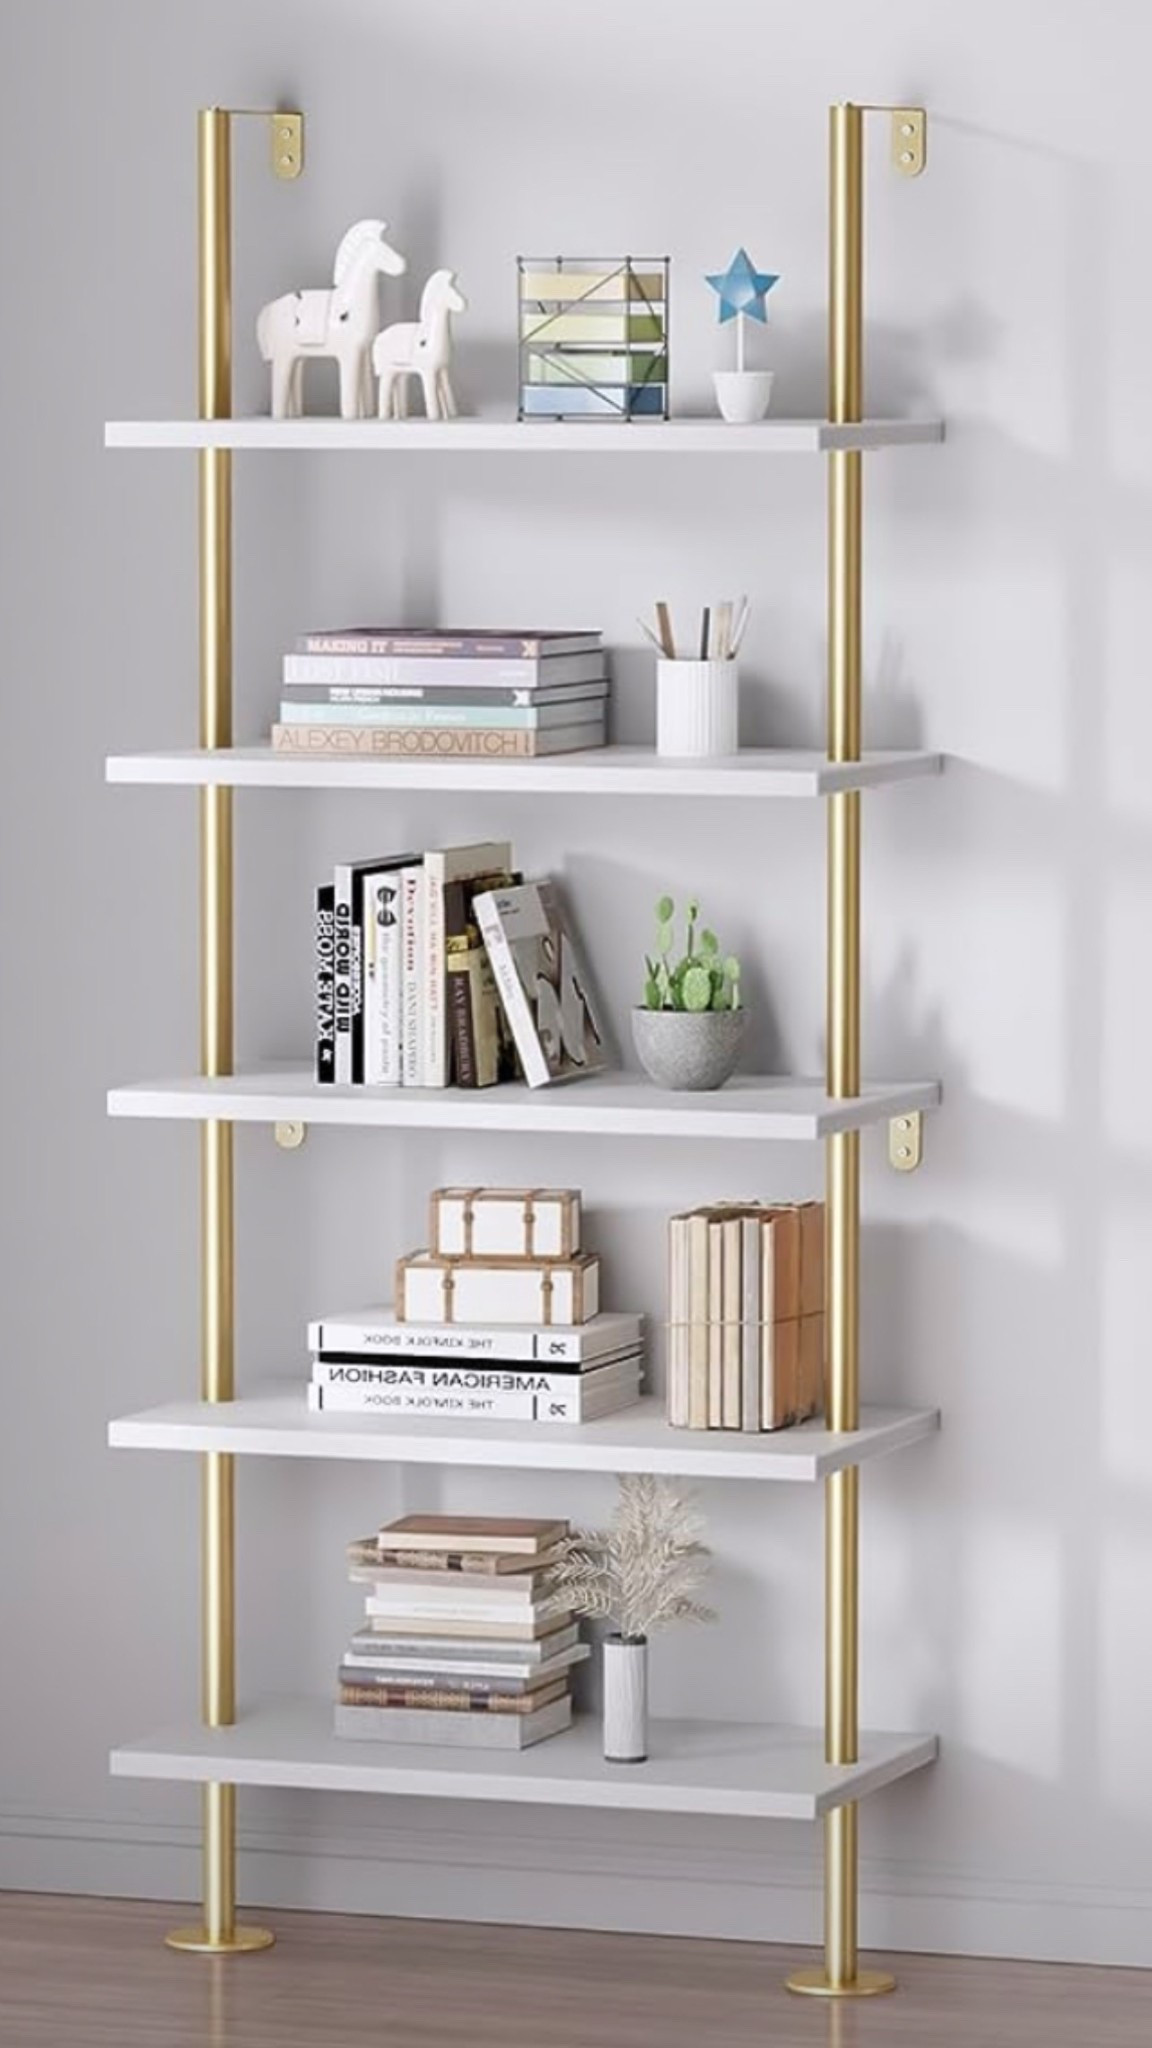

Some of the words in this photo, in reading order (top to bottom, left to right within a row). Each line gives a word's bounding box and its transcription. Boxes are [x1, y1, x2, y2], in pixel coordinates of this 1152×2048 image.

[307, 638, 368, 653] MAKING
[370, 639, 389, 653] IT
[279, 729, 365, 750] ALEXEY
[372, 730, 518, 752] BRODOVITCH
[406, 879, 417, 971] Devotion
[457, 1007, 472, 1081] BRADBURY
